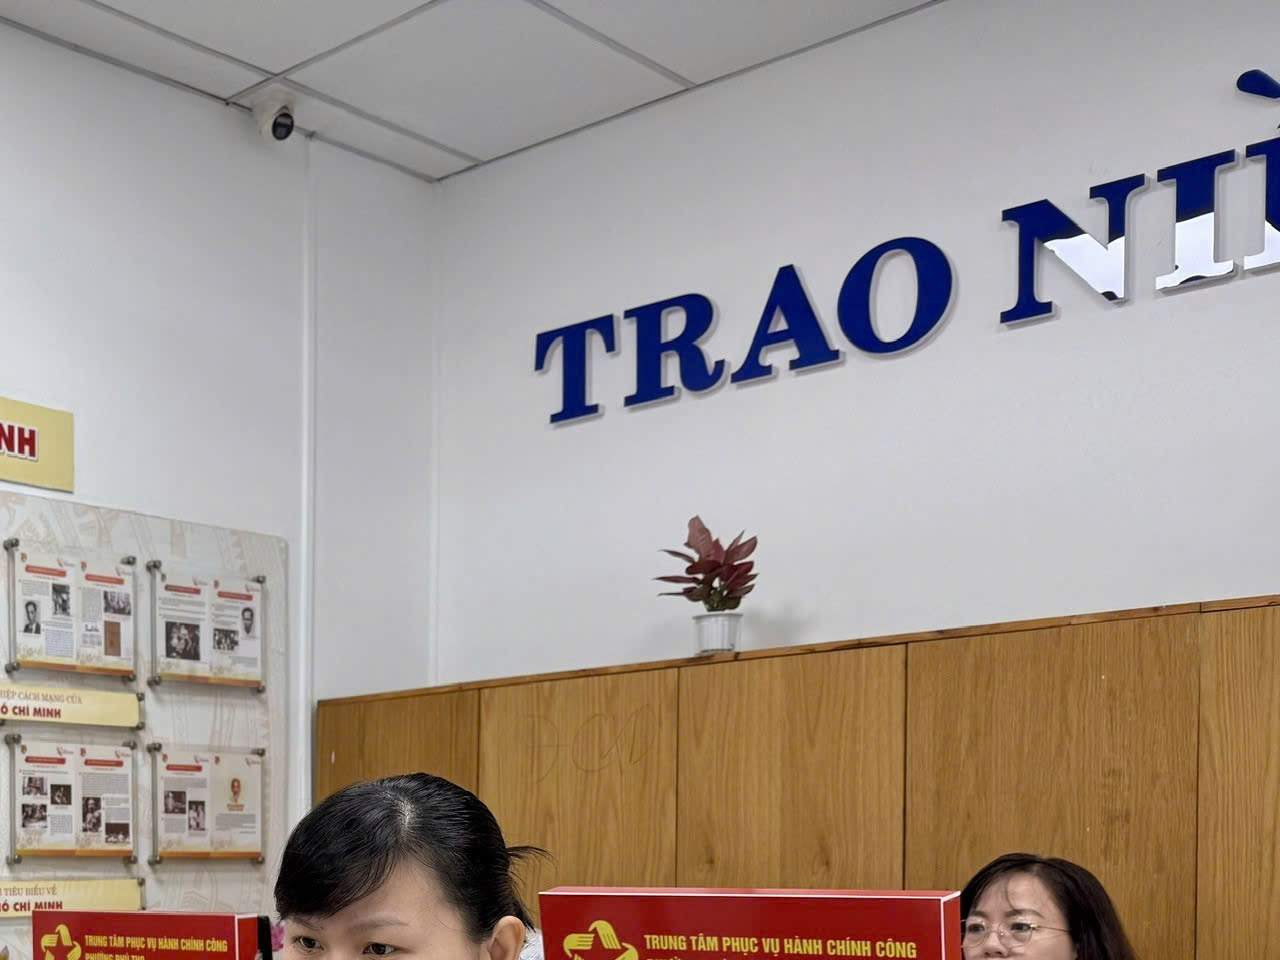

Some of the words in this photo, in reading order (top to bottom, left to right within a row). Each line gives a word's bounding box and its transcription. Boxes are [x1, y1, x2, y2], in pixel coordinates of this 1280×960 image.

[534, 235, 953, 424] TRAO
[12, 702, 30, 717] CHÍ
[33, 706, 61, 719] MINH
[13, 899, 31, 912] CHÍ
[34, 901, 63, 910] MINH
[85, 934, 107, 947] TRUNG
[109, 934, 124, 948] TÂM
[126, 936, 146, 952] PHỤC
[147, 937, 157, 952] VỤ
[158, 936, 179, 950] HÀNH
[180, 936, 204, 951] CHÍNH
[206, 937, 228, 952] CÔNG
[644, 934, 687, 952] TRUNG
[690, 933, 718, 953] TÂM
[722, 936, 759, 957] PHỤC
[762, 937, 780, 958] VỤ
[783, 935, 823, 955] HÀNH
[826, 936, 871, 957] CHÍNH
[875, 938, 917, 959] CÔNG
